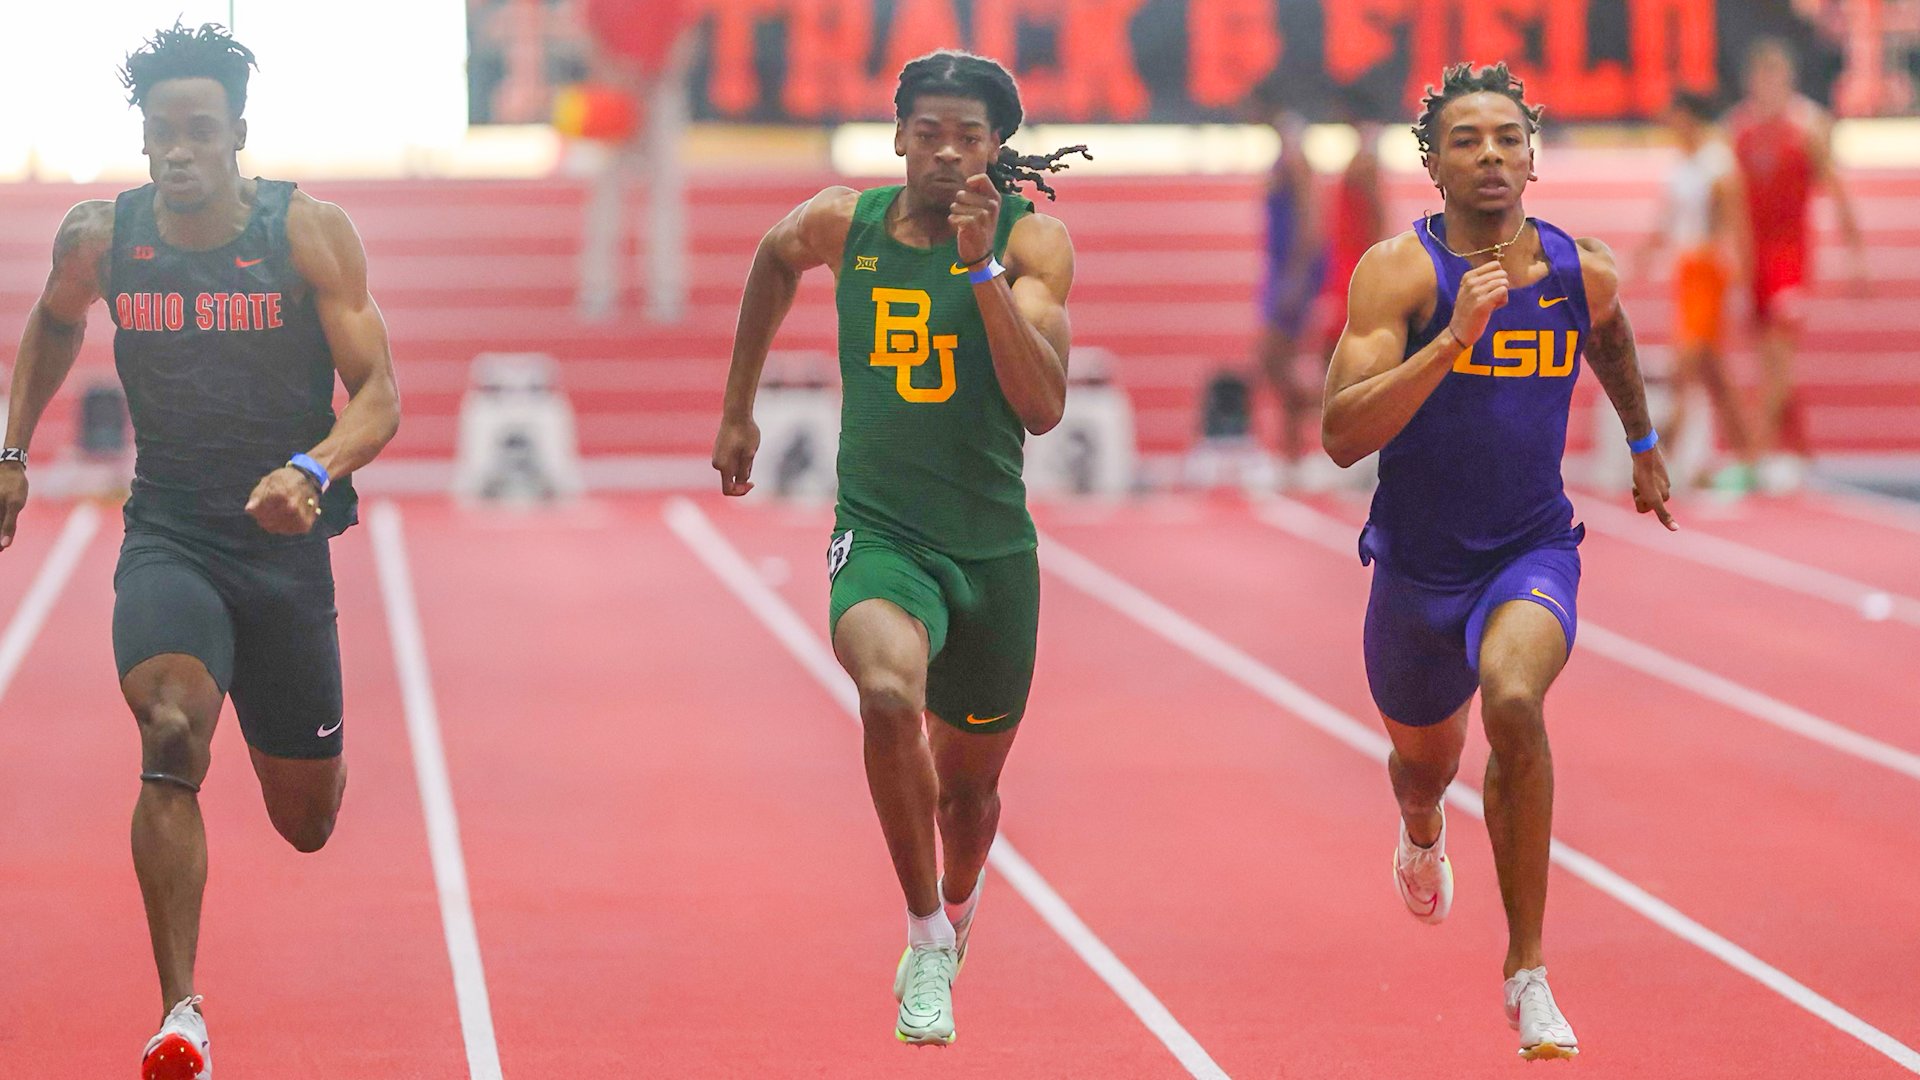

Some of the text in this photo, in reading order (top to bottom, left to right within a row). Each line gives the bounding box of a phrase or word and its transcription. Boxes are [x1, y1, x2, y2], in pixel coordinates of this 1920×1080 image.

[679, 0, 1151, 121] TRACK
[1322, 0, 1718, 118] FIELD
[116, 292, 284, 332] OHIO STATE
[869, 287, 959, 403] BU
[1452, 330, 1580, 378] LSU
